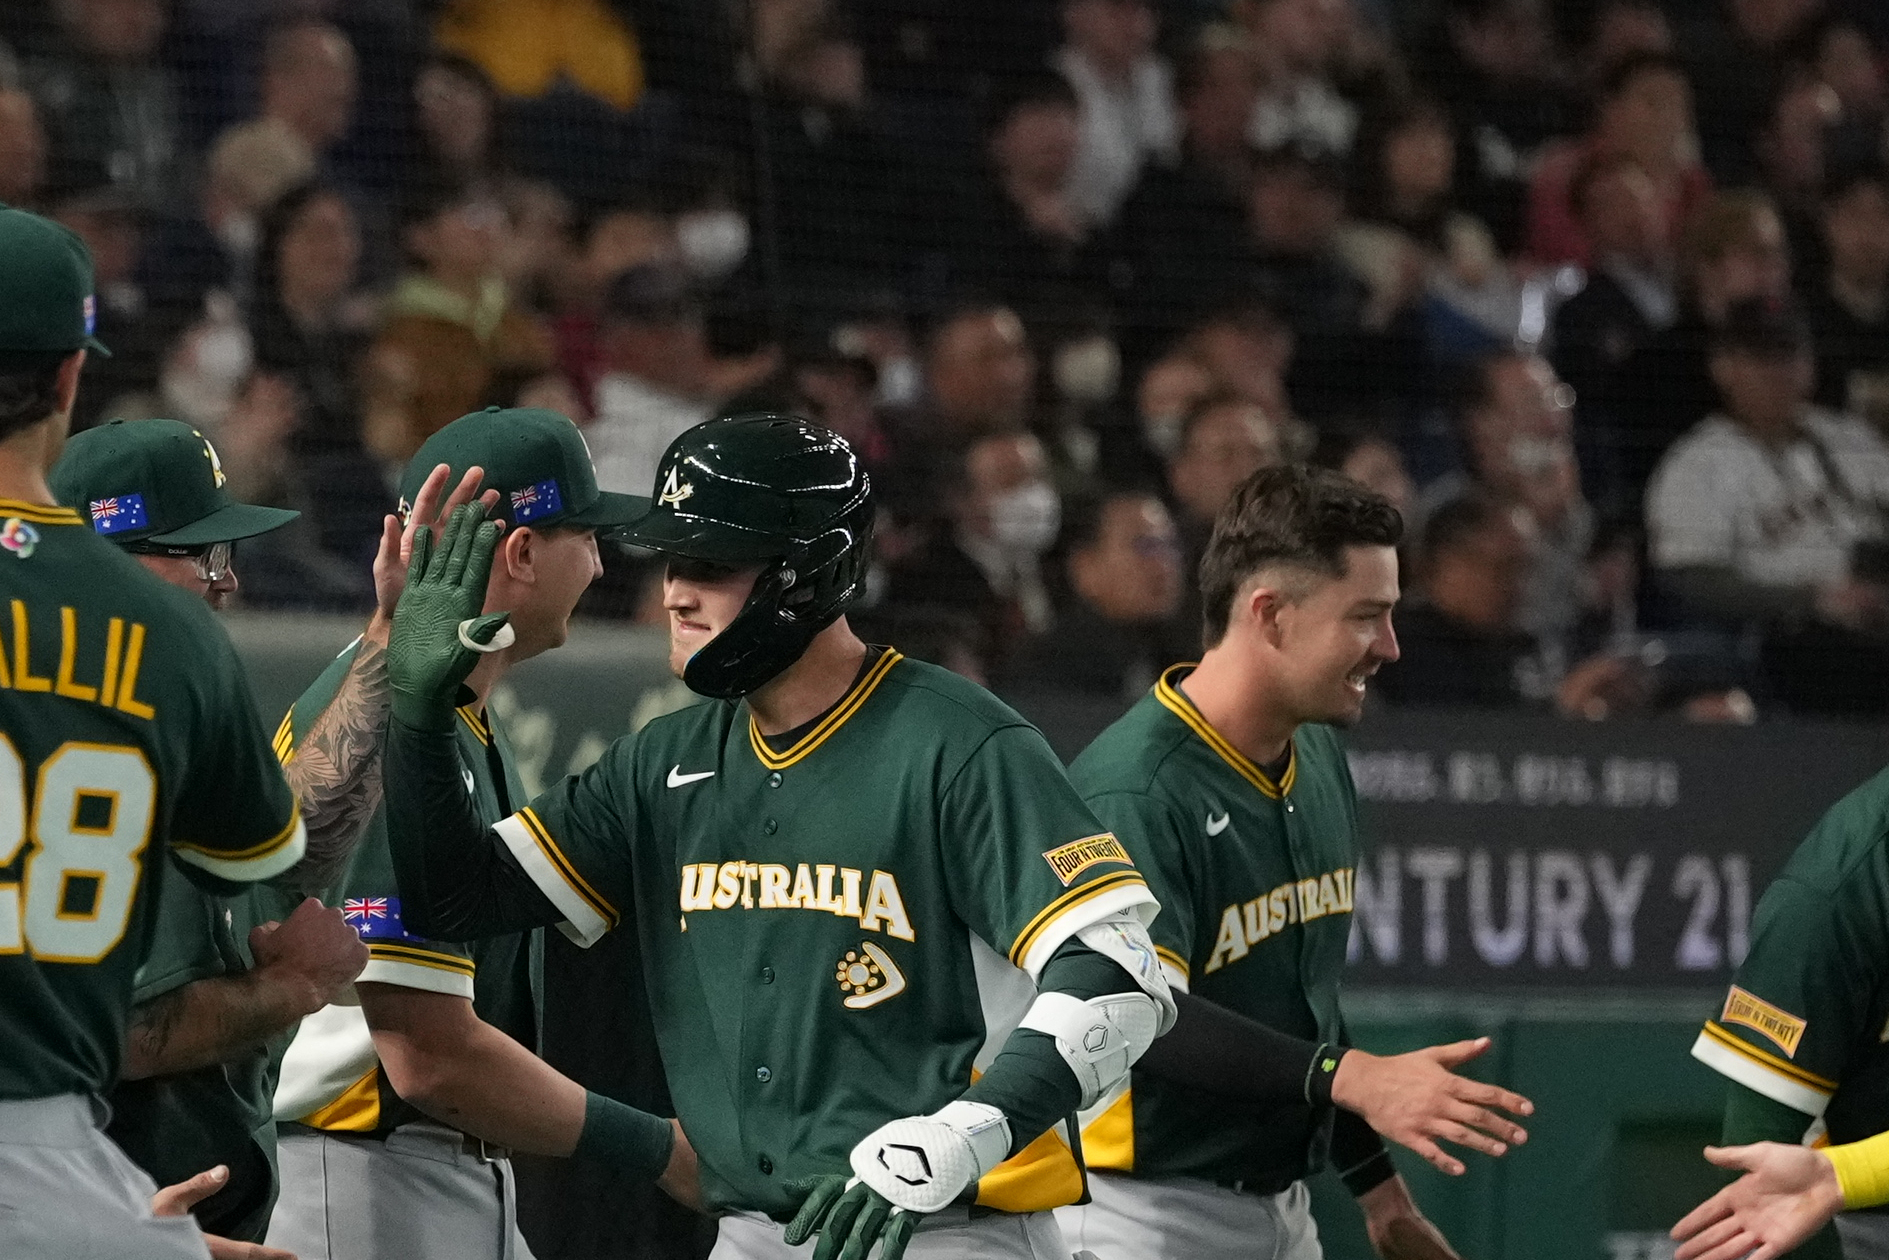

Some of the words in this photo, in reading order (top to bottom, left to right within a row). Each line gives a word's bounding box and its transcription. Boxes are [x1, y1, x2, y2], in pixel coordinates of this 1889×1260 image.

[680, 860, 915, 942] USTRALIA
[1347, 845, 1653, 969] NTURY
[1673, 852, 1753, 971] 21
